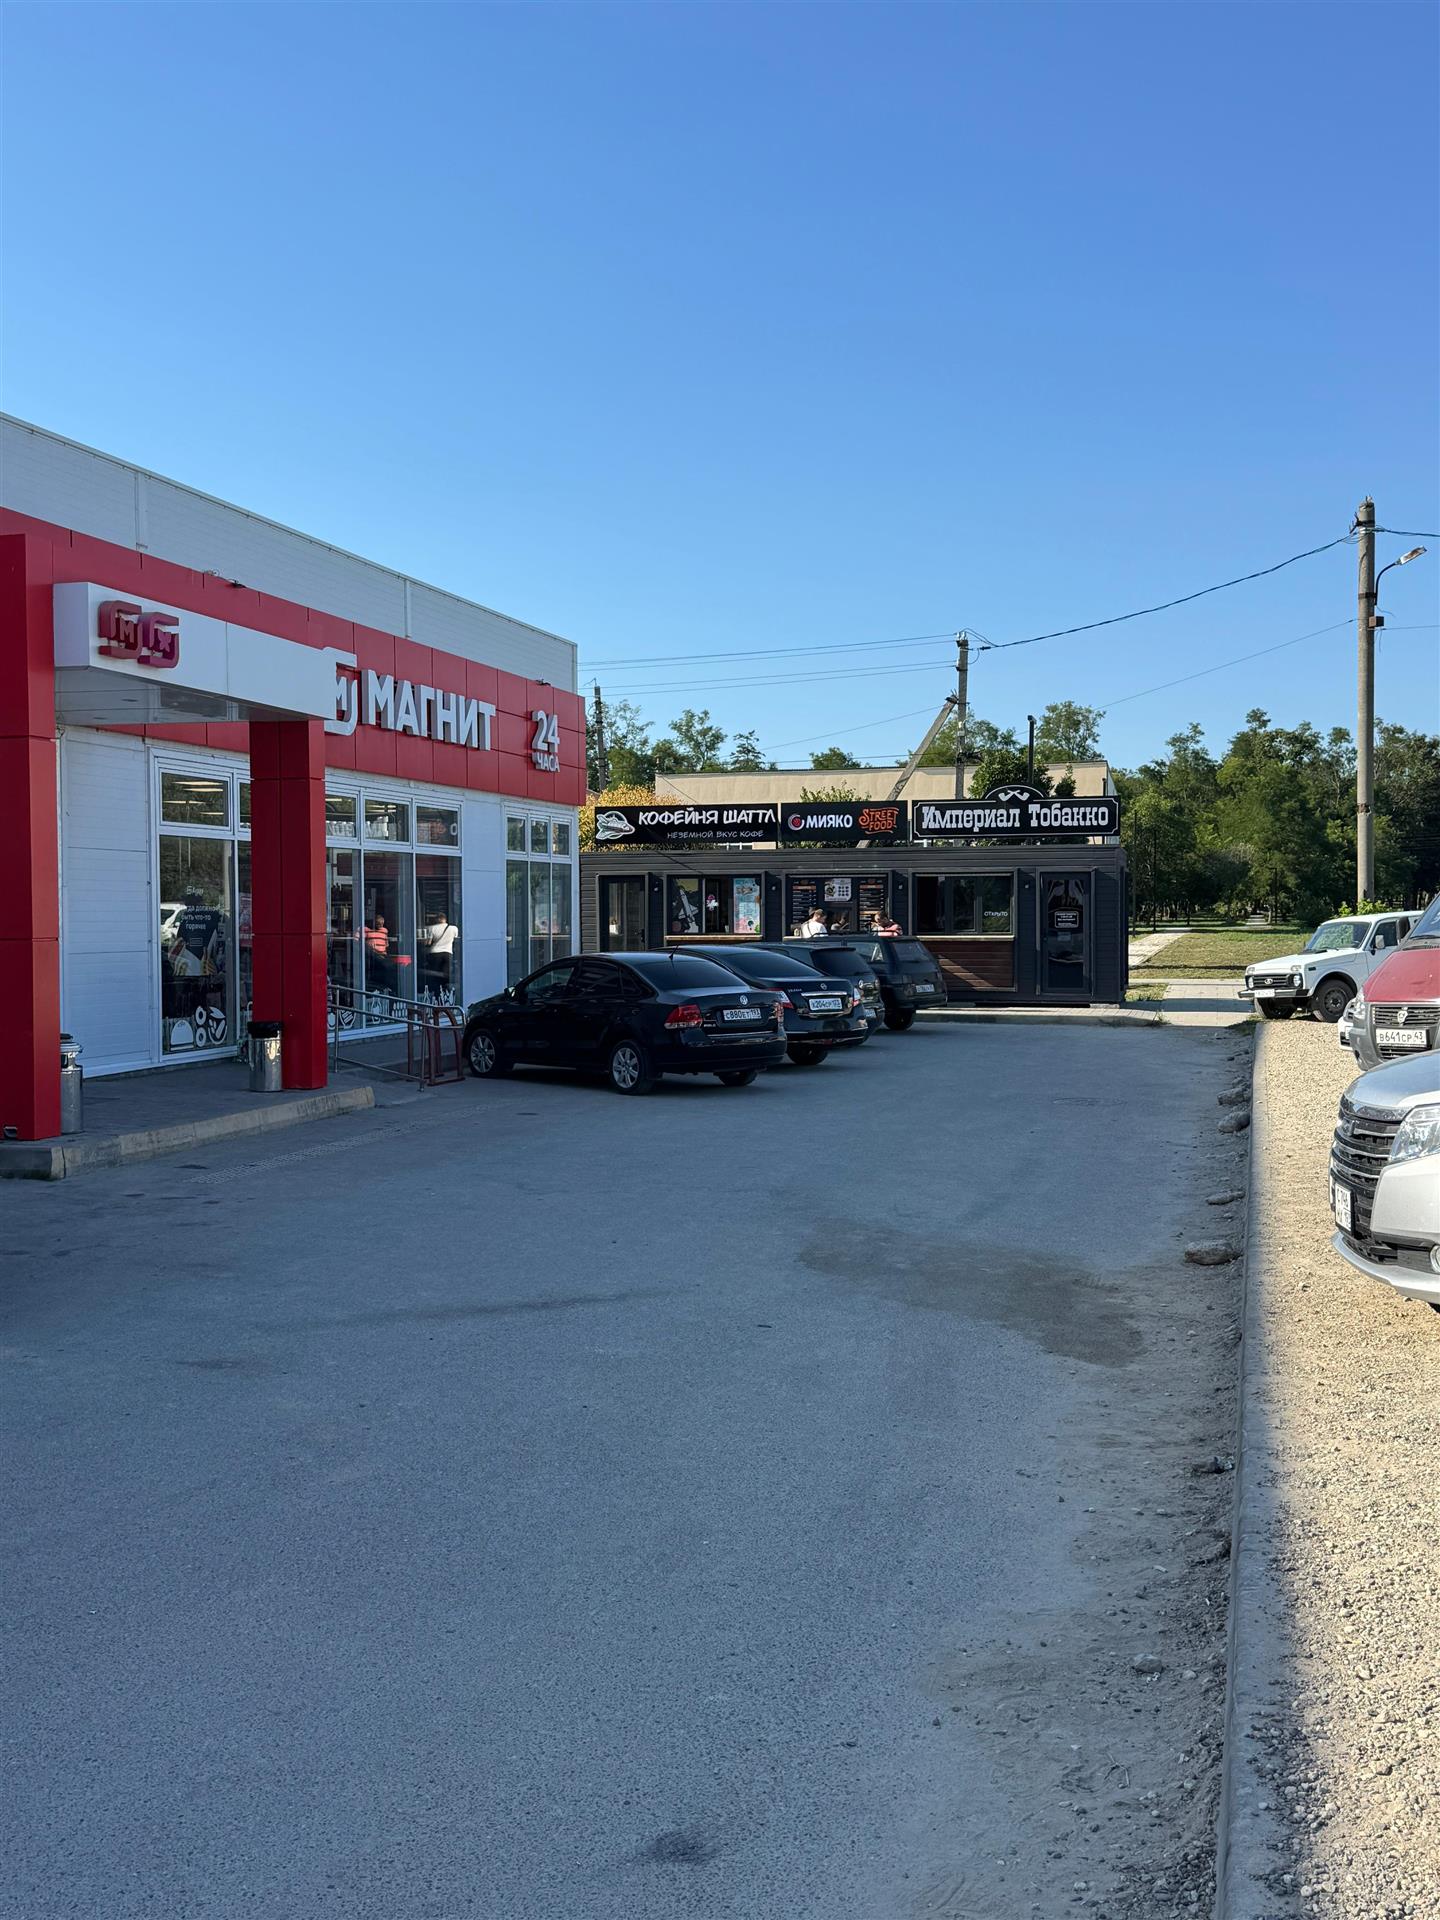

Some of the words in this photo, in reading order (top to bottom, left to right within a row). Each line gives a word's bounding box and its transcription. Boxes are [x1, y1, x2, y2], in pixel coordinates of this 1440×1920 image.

[362, 669, 496, 751] МАГНИТ
[533, 710, 561, 753] 24
[534, 752, 561, 773] ЧАСА
[638, 807, 718, 826] КОФЕЙНЯ
[722, 809, 776, 825] ШАТТЛ
[805, 814, 853, 829] МИЯКО
[858, 808, 899, 826] STREET
[869, 820, 893, 831] FOOD
[922, 806, 1020, 832] Империал
[1028, 803, 1109, 828] Тобакко
[667, 830, 714, 839] НЕЗЕМНОЙ
[716, 830, 738, 838] ВКУС
[739, 829, 764, 838] КОФЕ
[1380, 1031, 1412, 1042] В641СР
